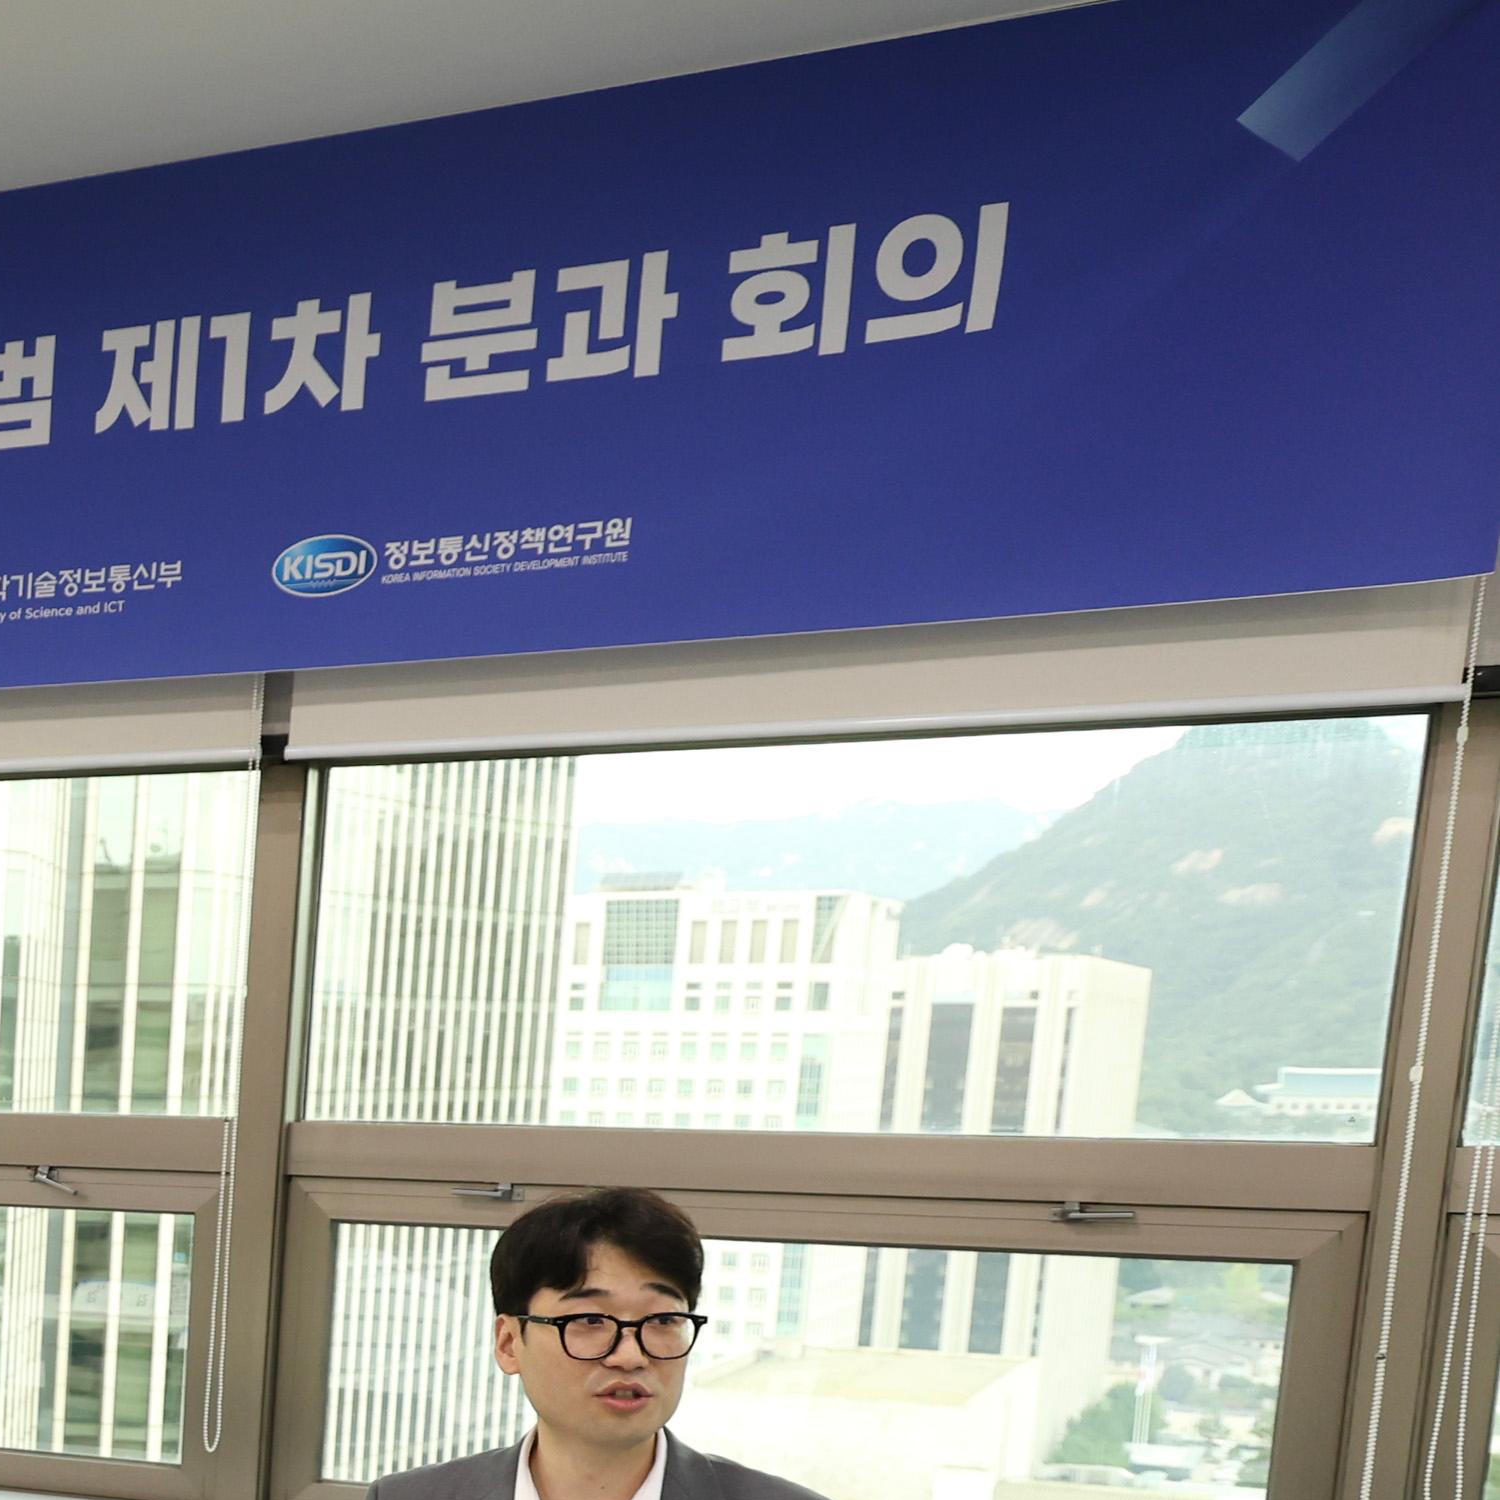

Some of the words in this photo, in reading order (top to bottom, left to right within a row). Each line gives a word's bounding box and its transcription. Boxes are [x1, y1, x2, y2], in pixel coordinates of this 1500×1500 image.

[94, 292, 381, 434] 제1차
[420, 250, 679, 402] 분과
[721, 201, 1009, 362] 회의
[384, 517, 632, 570] 정보통신정책연구원
[282, 550, 367, 581] KISDI
[381, 573, 411, 584] KOREA
[412, 567, 472, 582] INFORMATION
[473, 563, 511, 576] SOCIETY
[513, 557, 580, 571] DEVELOPMENT
[8, 607, 22, 621] of
[24, 605, 74, 620] Science
[75, 601, 101, 616] and
[102, 599, 126, 614] ICT
